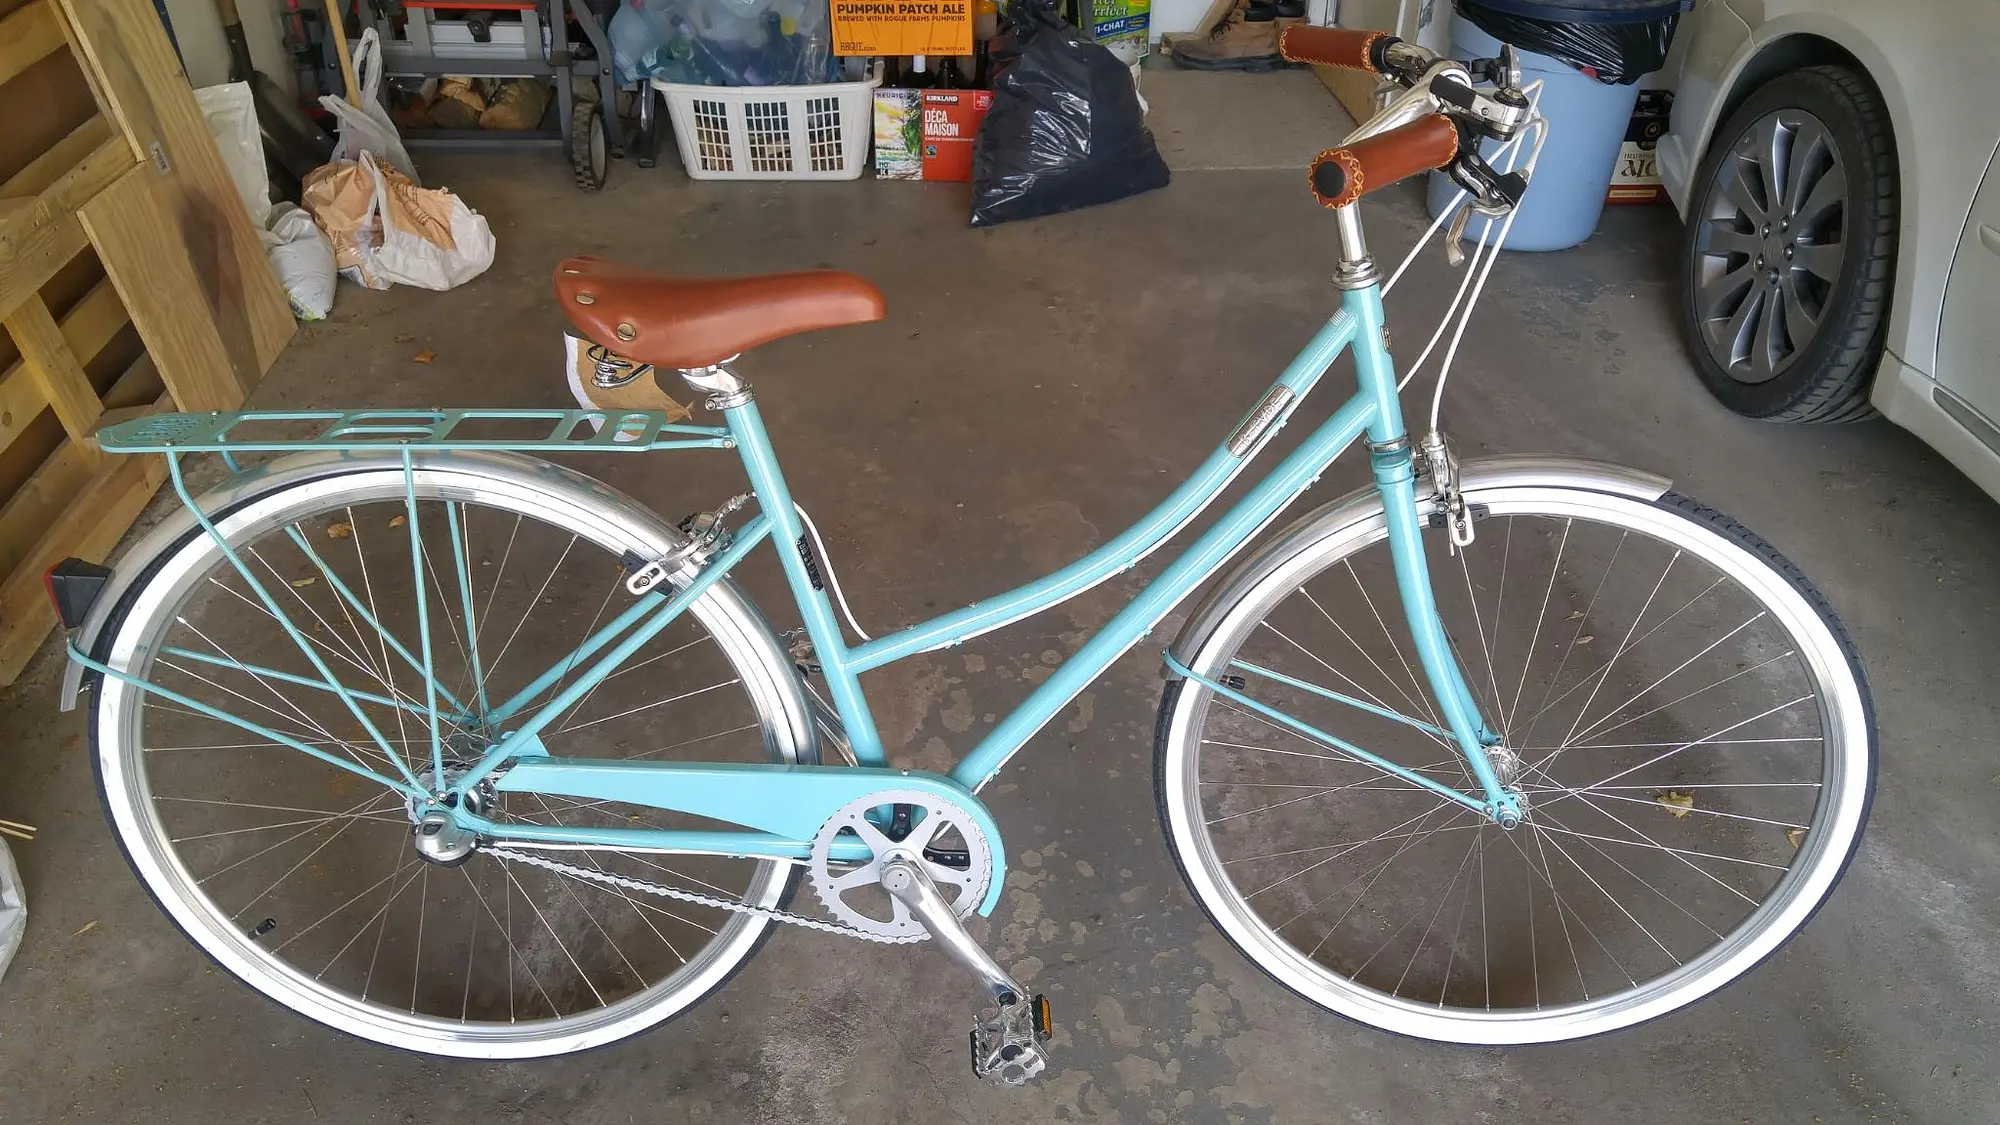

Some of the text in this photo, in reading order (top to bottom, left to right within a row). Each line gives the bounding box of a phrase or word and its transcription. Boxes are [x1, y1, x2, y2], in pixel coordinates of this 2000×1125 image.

[837, 4, 965, 14] PUMPKIN PATCH ALE
[925, 108, 948, 123] DÉCA
[924, 123, 959, 136] MAISON
